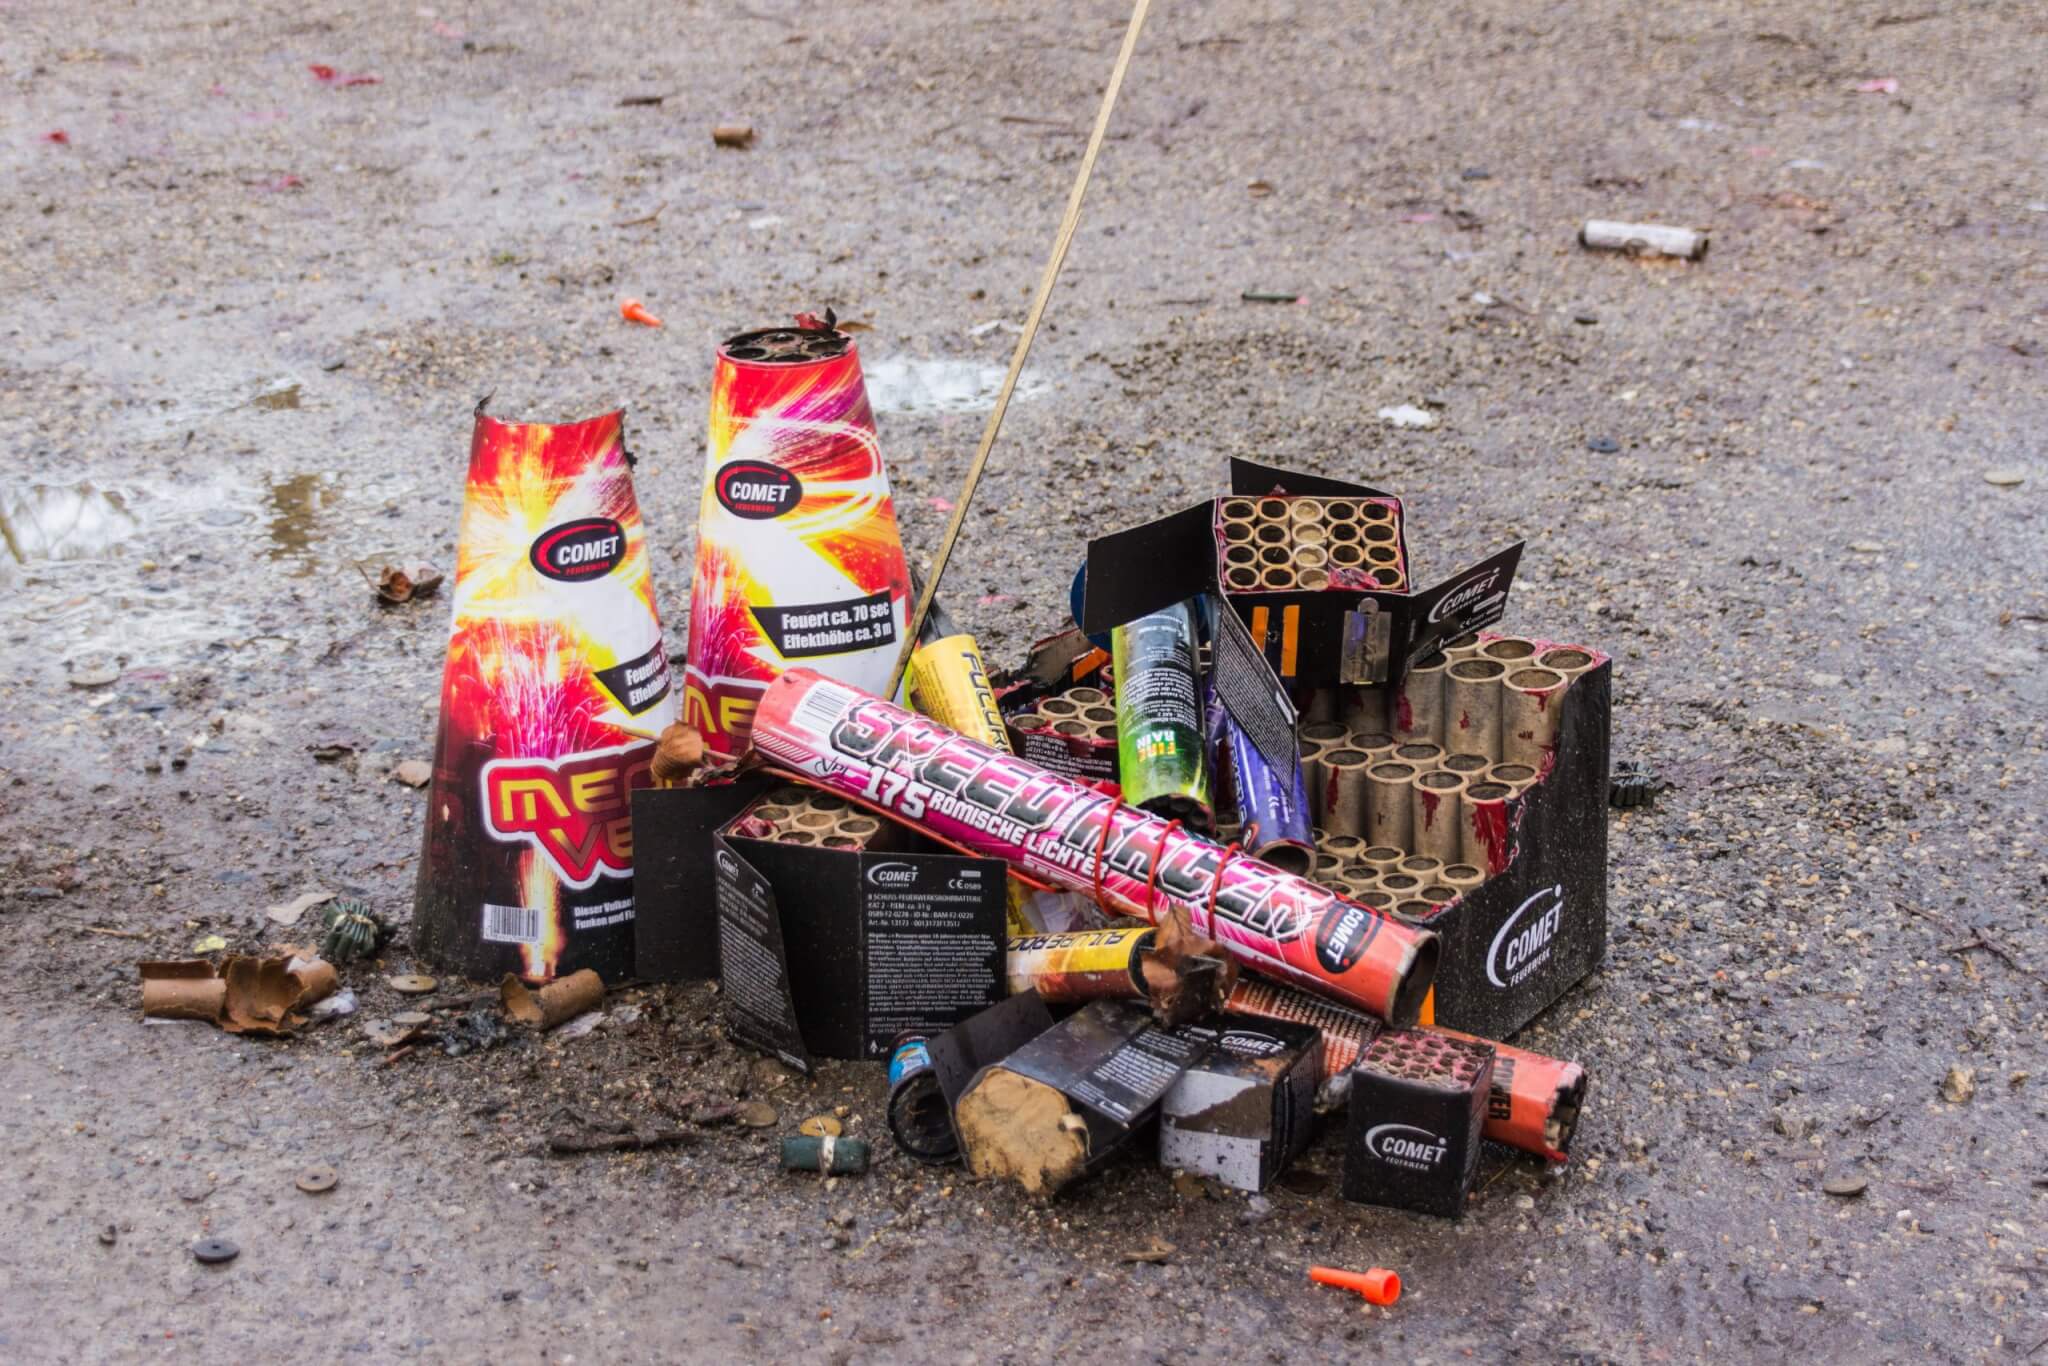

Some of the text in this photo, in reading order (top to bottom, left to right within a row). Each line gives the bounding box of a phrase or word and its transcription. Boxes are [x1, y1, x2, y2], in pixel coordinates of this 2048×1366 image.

[729, 481, 791, 503] COMET
[557, 535, 619, 566] COMET
[1441, 573, 1500, 614] COMET
[781, 601, 889, 630] Feuert ca. 70 sec
[783, 621, 892, 650] Effekthöhe ca. 3 m
[1135, 729, 1175, 750] RAIN
[1136, 741, 1176, 764] FIRE
[829, 699, 1087, 831] SPEED
[861, 766, 932, 820] 175
[1025, 832, 1110, 881] LICHTER
[879, 871, 919, 882] COMET
[574, 904, 603, 917] Dieser
[608, 911, 625, 925] und
[1325, 908, 1365, 966] COMET
[1505, 901, 1564, 971] COMET
[1220, 1035, 1284, 1053] COMET
[1487, 1057, 1516, 1121] POWER
[1382, 1136, 1447, 1163] COMET
